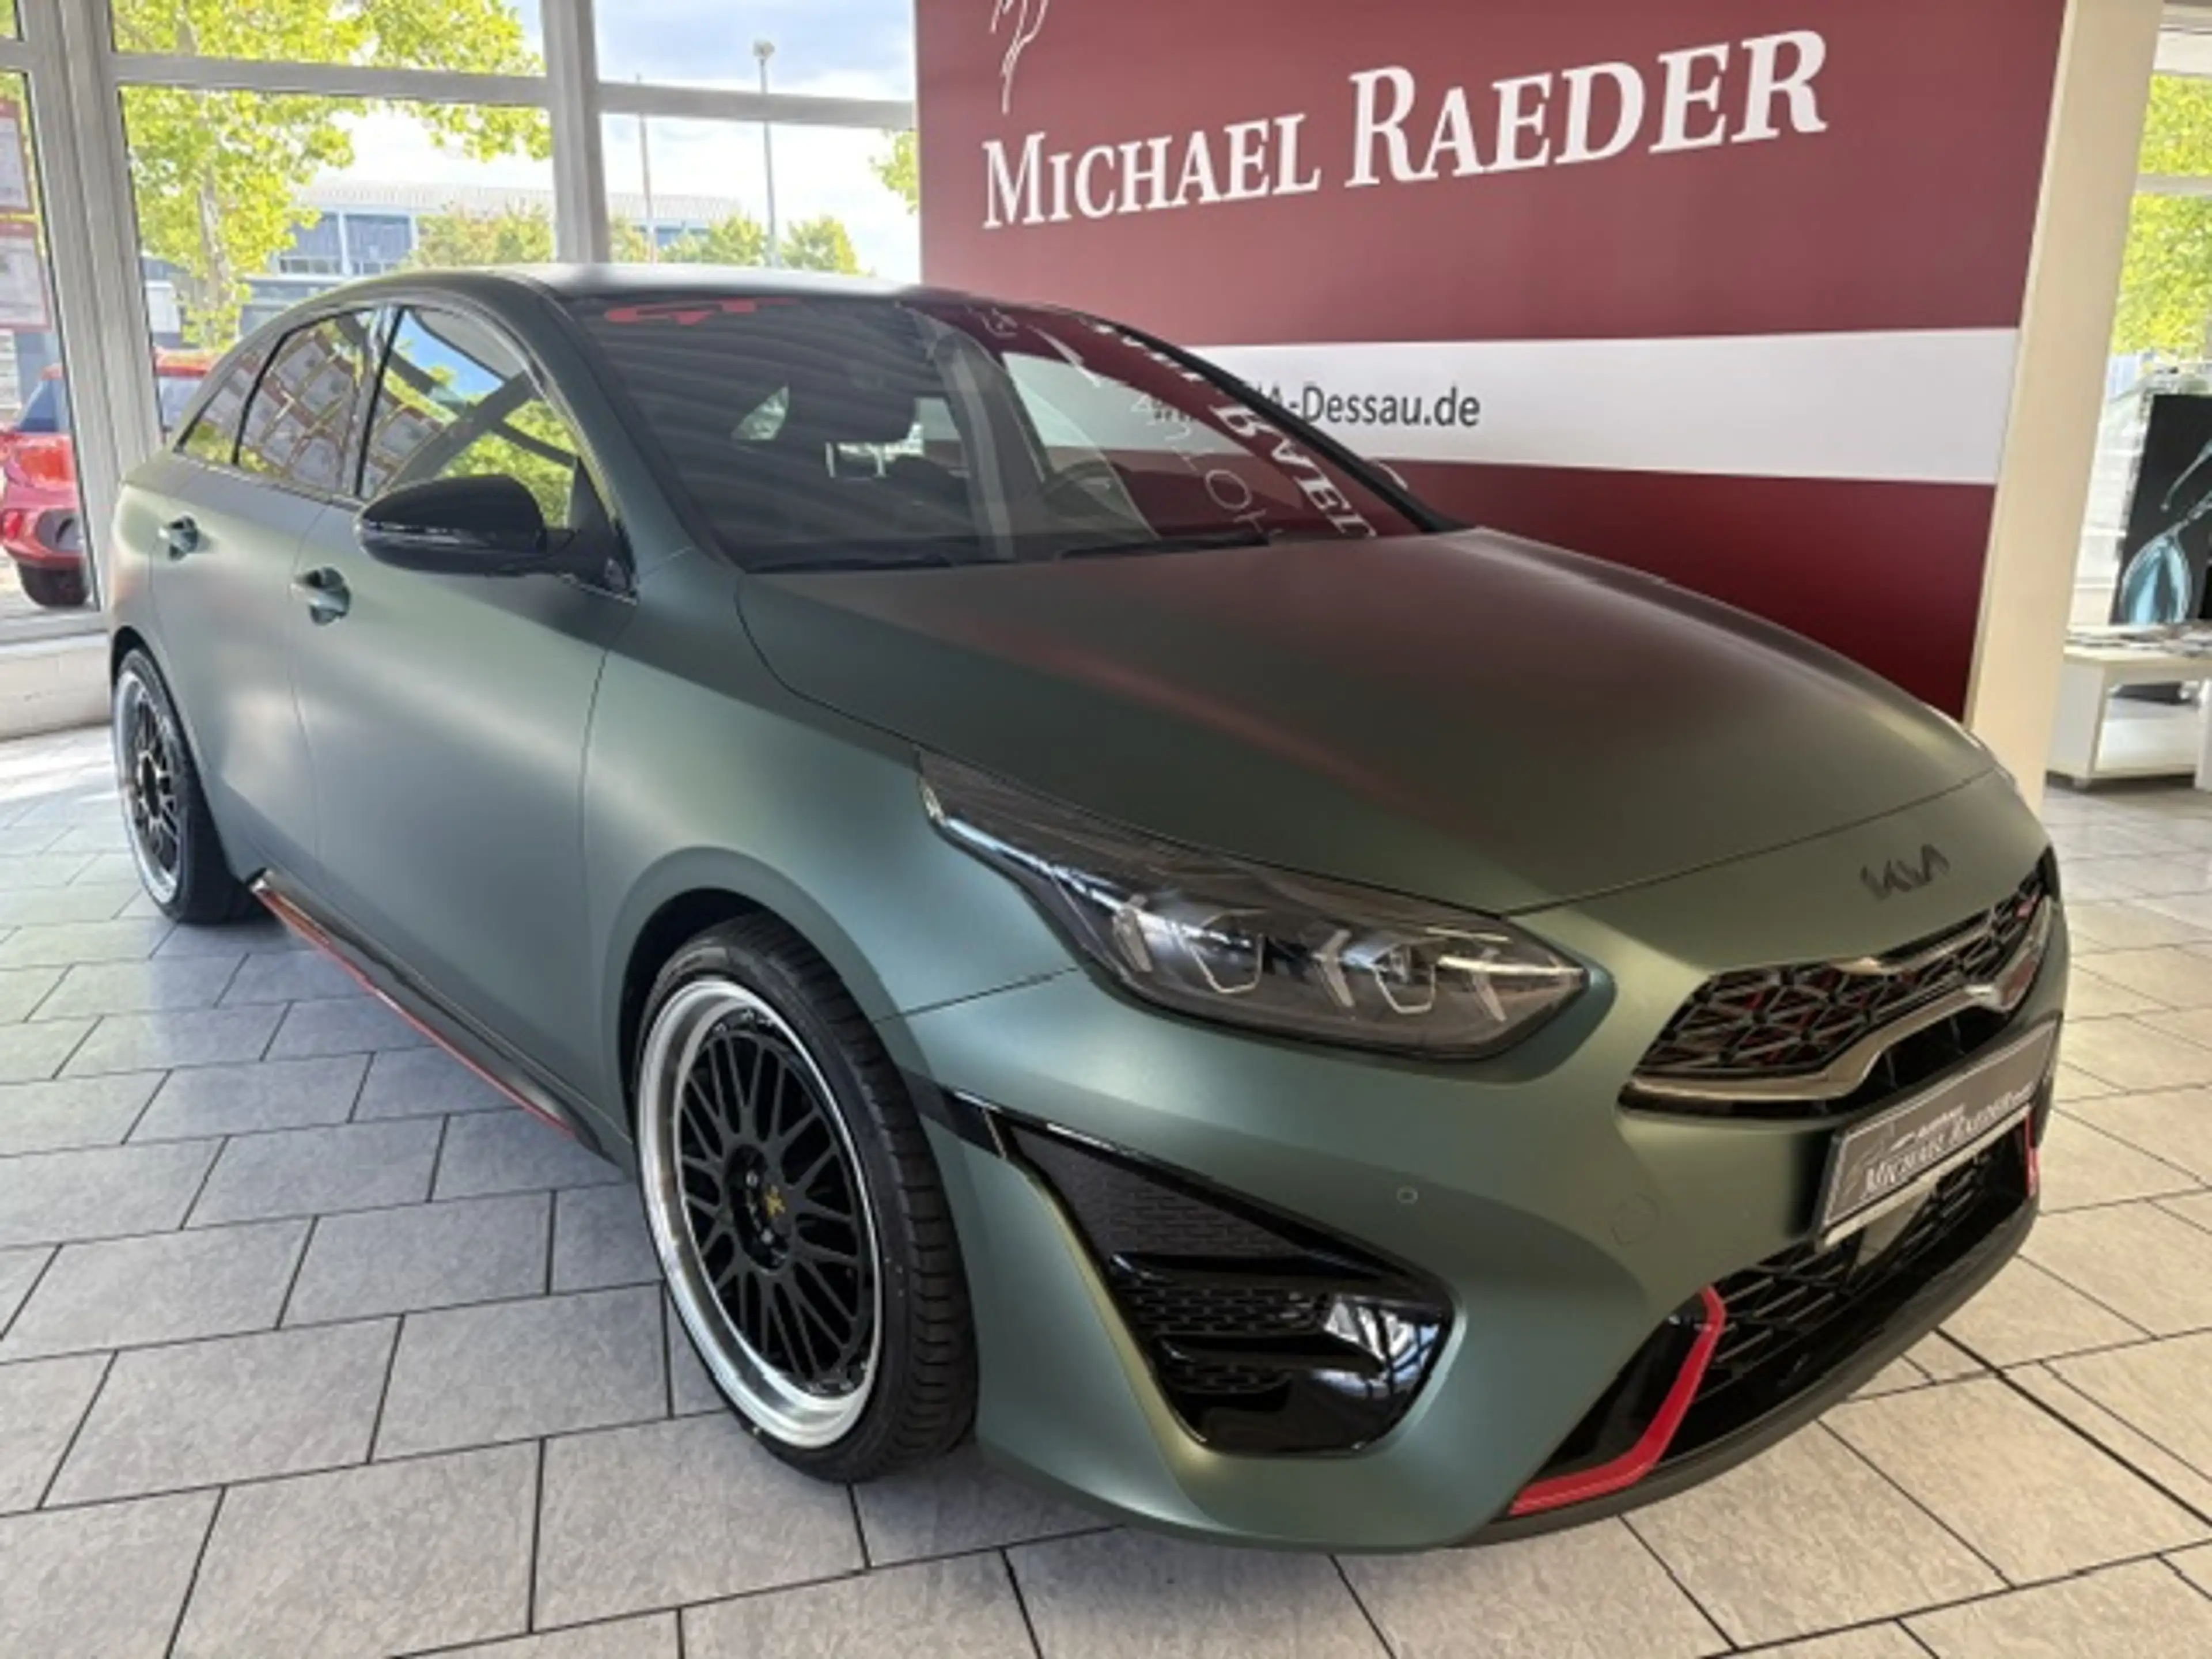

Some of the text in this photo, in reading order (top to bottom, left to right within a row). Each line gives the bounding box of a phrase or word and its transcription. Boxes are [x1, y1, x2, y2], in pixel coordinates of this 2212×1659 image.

[982, 29, 1828, 229] MICHAEL RAEDER
[1860, 843, 1951, 900] KIA
